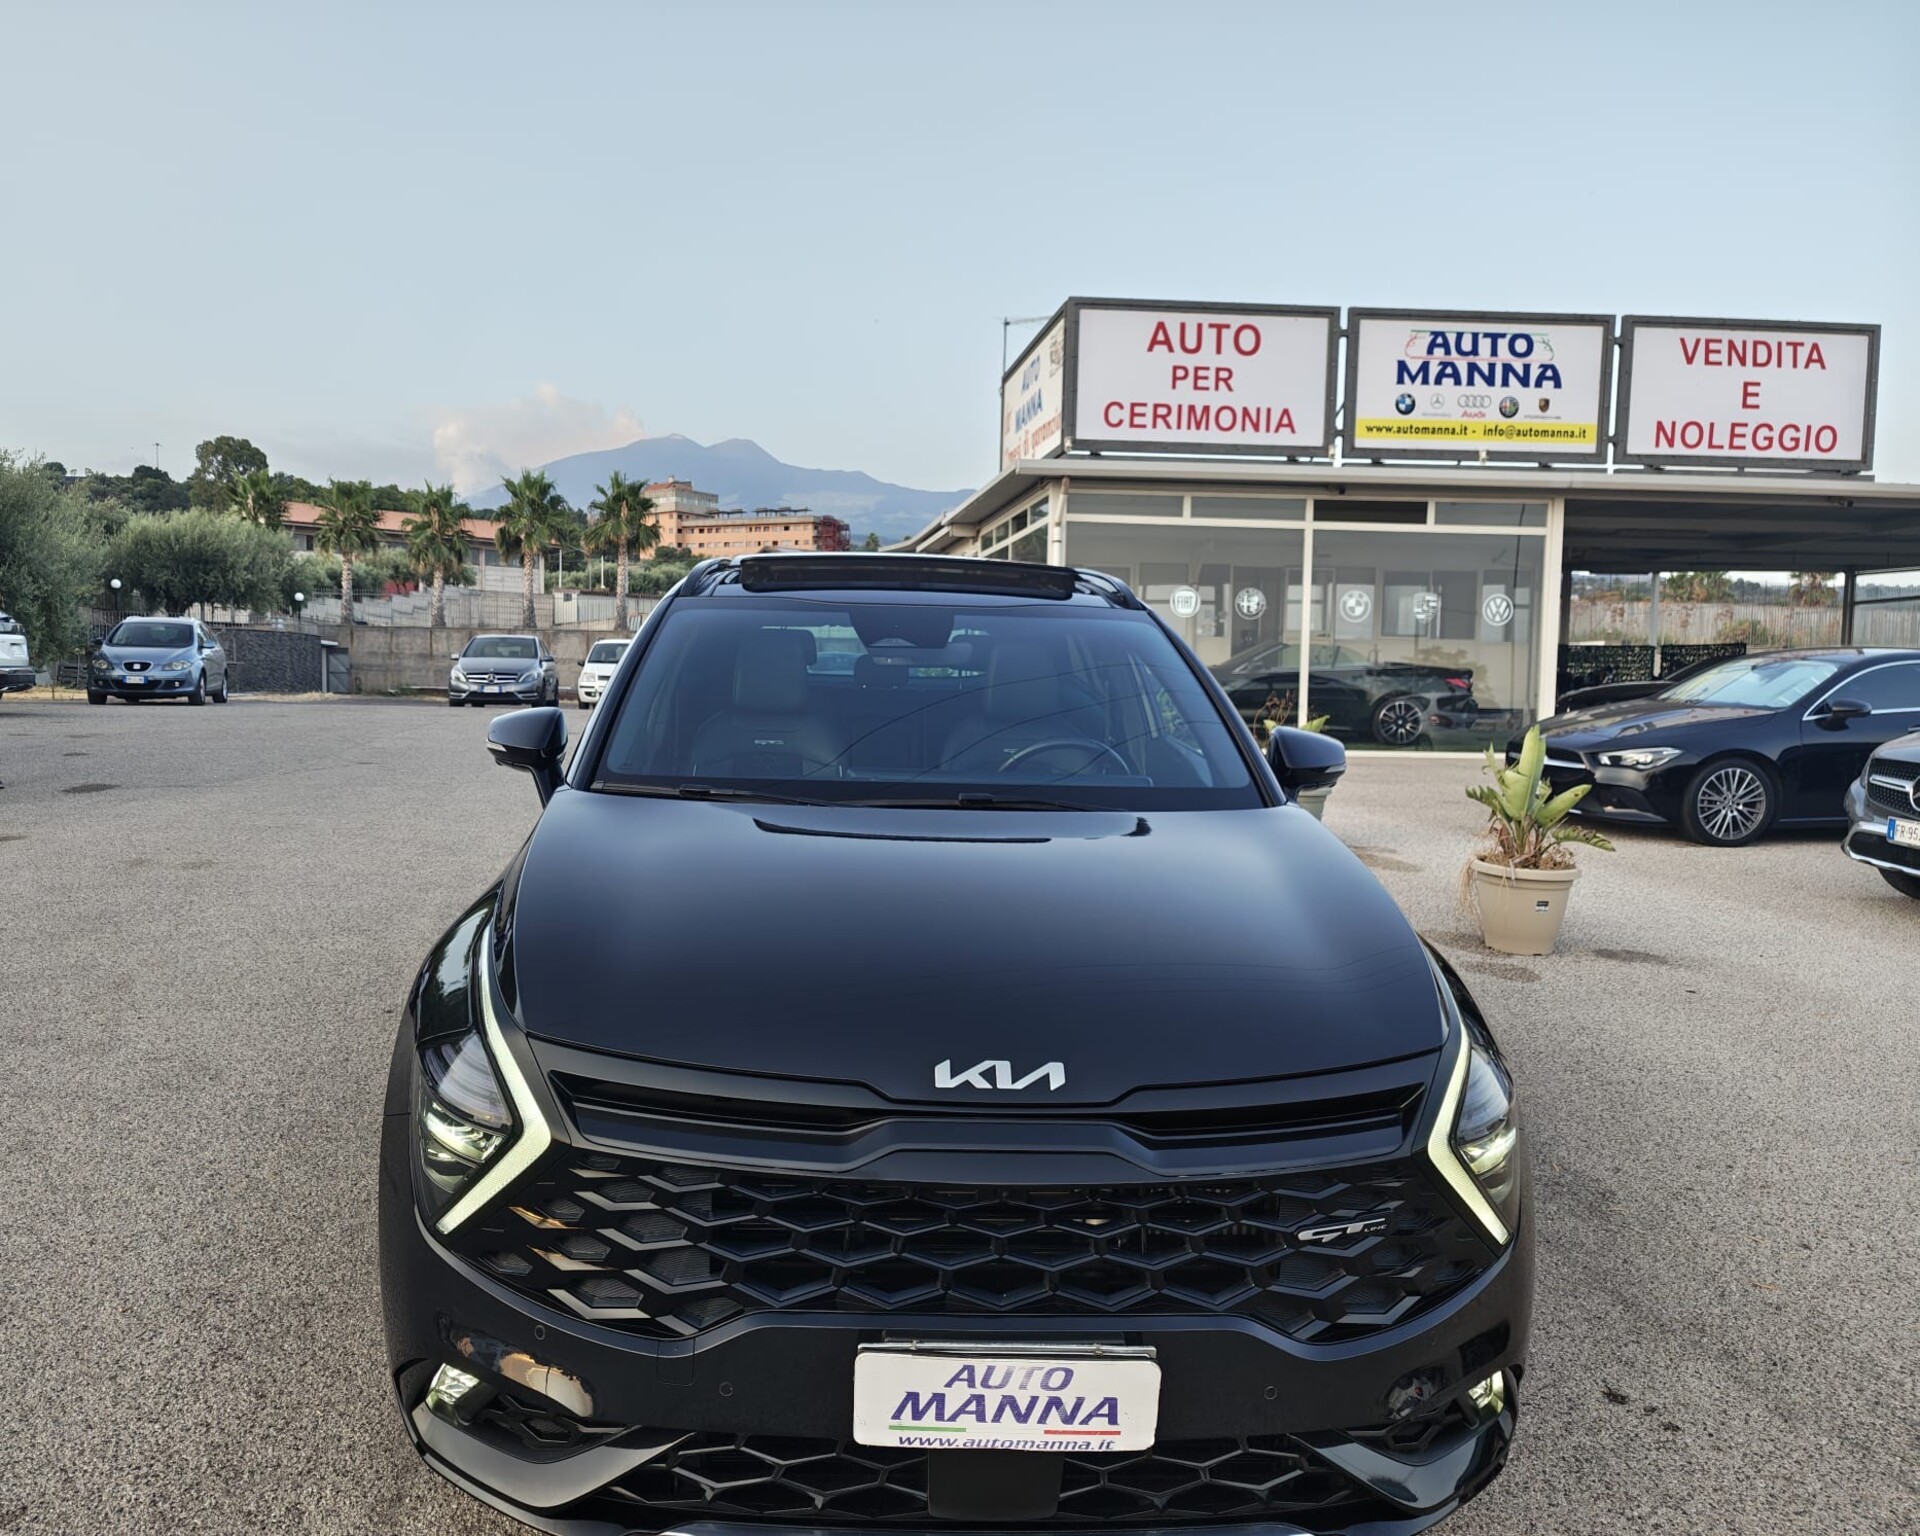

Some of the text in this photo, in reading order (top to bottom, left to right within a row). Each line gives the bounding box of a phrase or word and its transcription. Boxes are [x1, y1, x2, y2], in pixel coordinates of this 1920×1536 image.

[1147, 321, 1261, 357] AUTO
[1426, 331, 1534, 358] AUTO
[1680, 337, 1826, 370] VENDITA
[1171, 365, 1233, 392] PER
[1396, 360, 1562, 389] MANNA
[1741, 381, 1761, 409] E
[1103, 401, 1296, 434] CERIMONIA
[1461, 410, 1486, 418] Audi
[1365, 422, 1468, 436] www.automanna.it
[1482, 425, 1587, 439] info@automanna.it
[1654, 420, 1838, 453] NOLEGGIO
[934, 1058, 1066, 1091] KIA
[943, 1364, 1075, 1392] AUTO
[890, 1391, 1121, 1426] MANNA
[898, 1435, 1115, 1451] www.automanna.it
